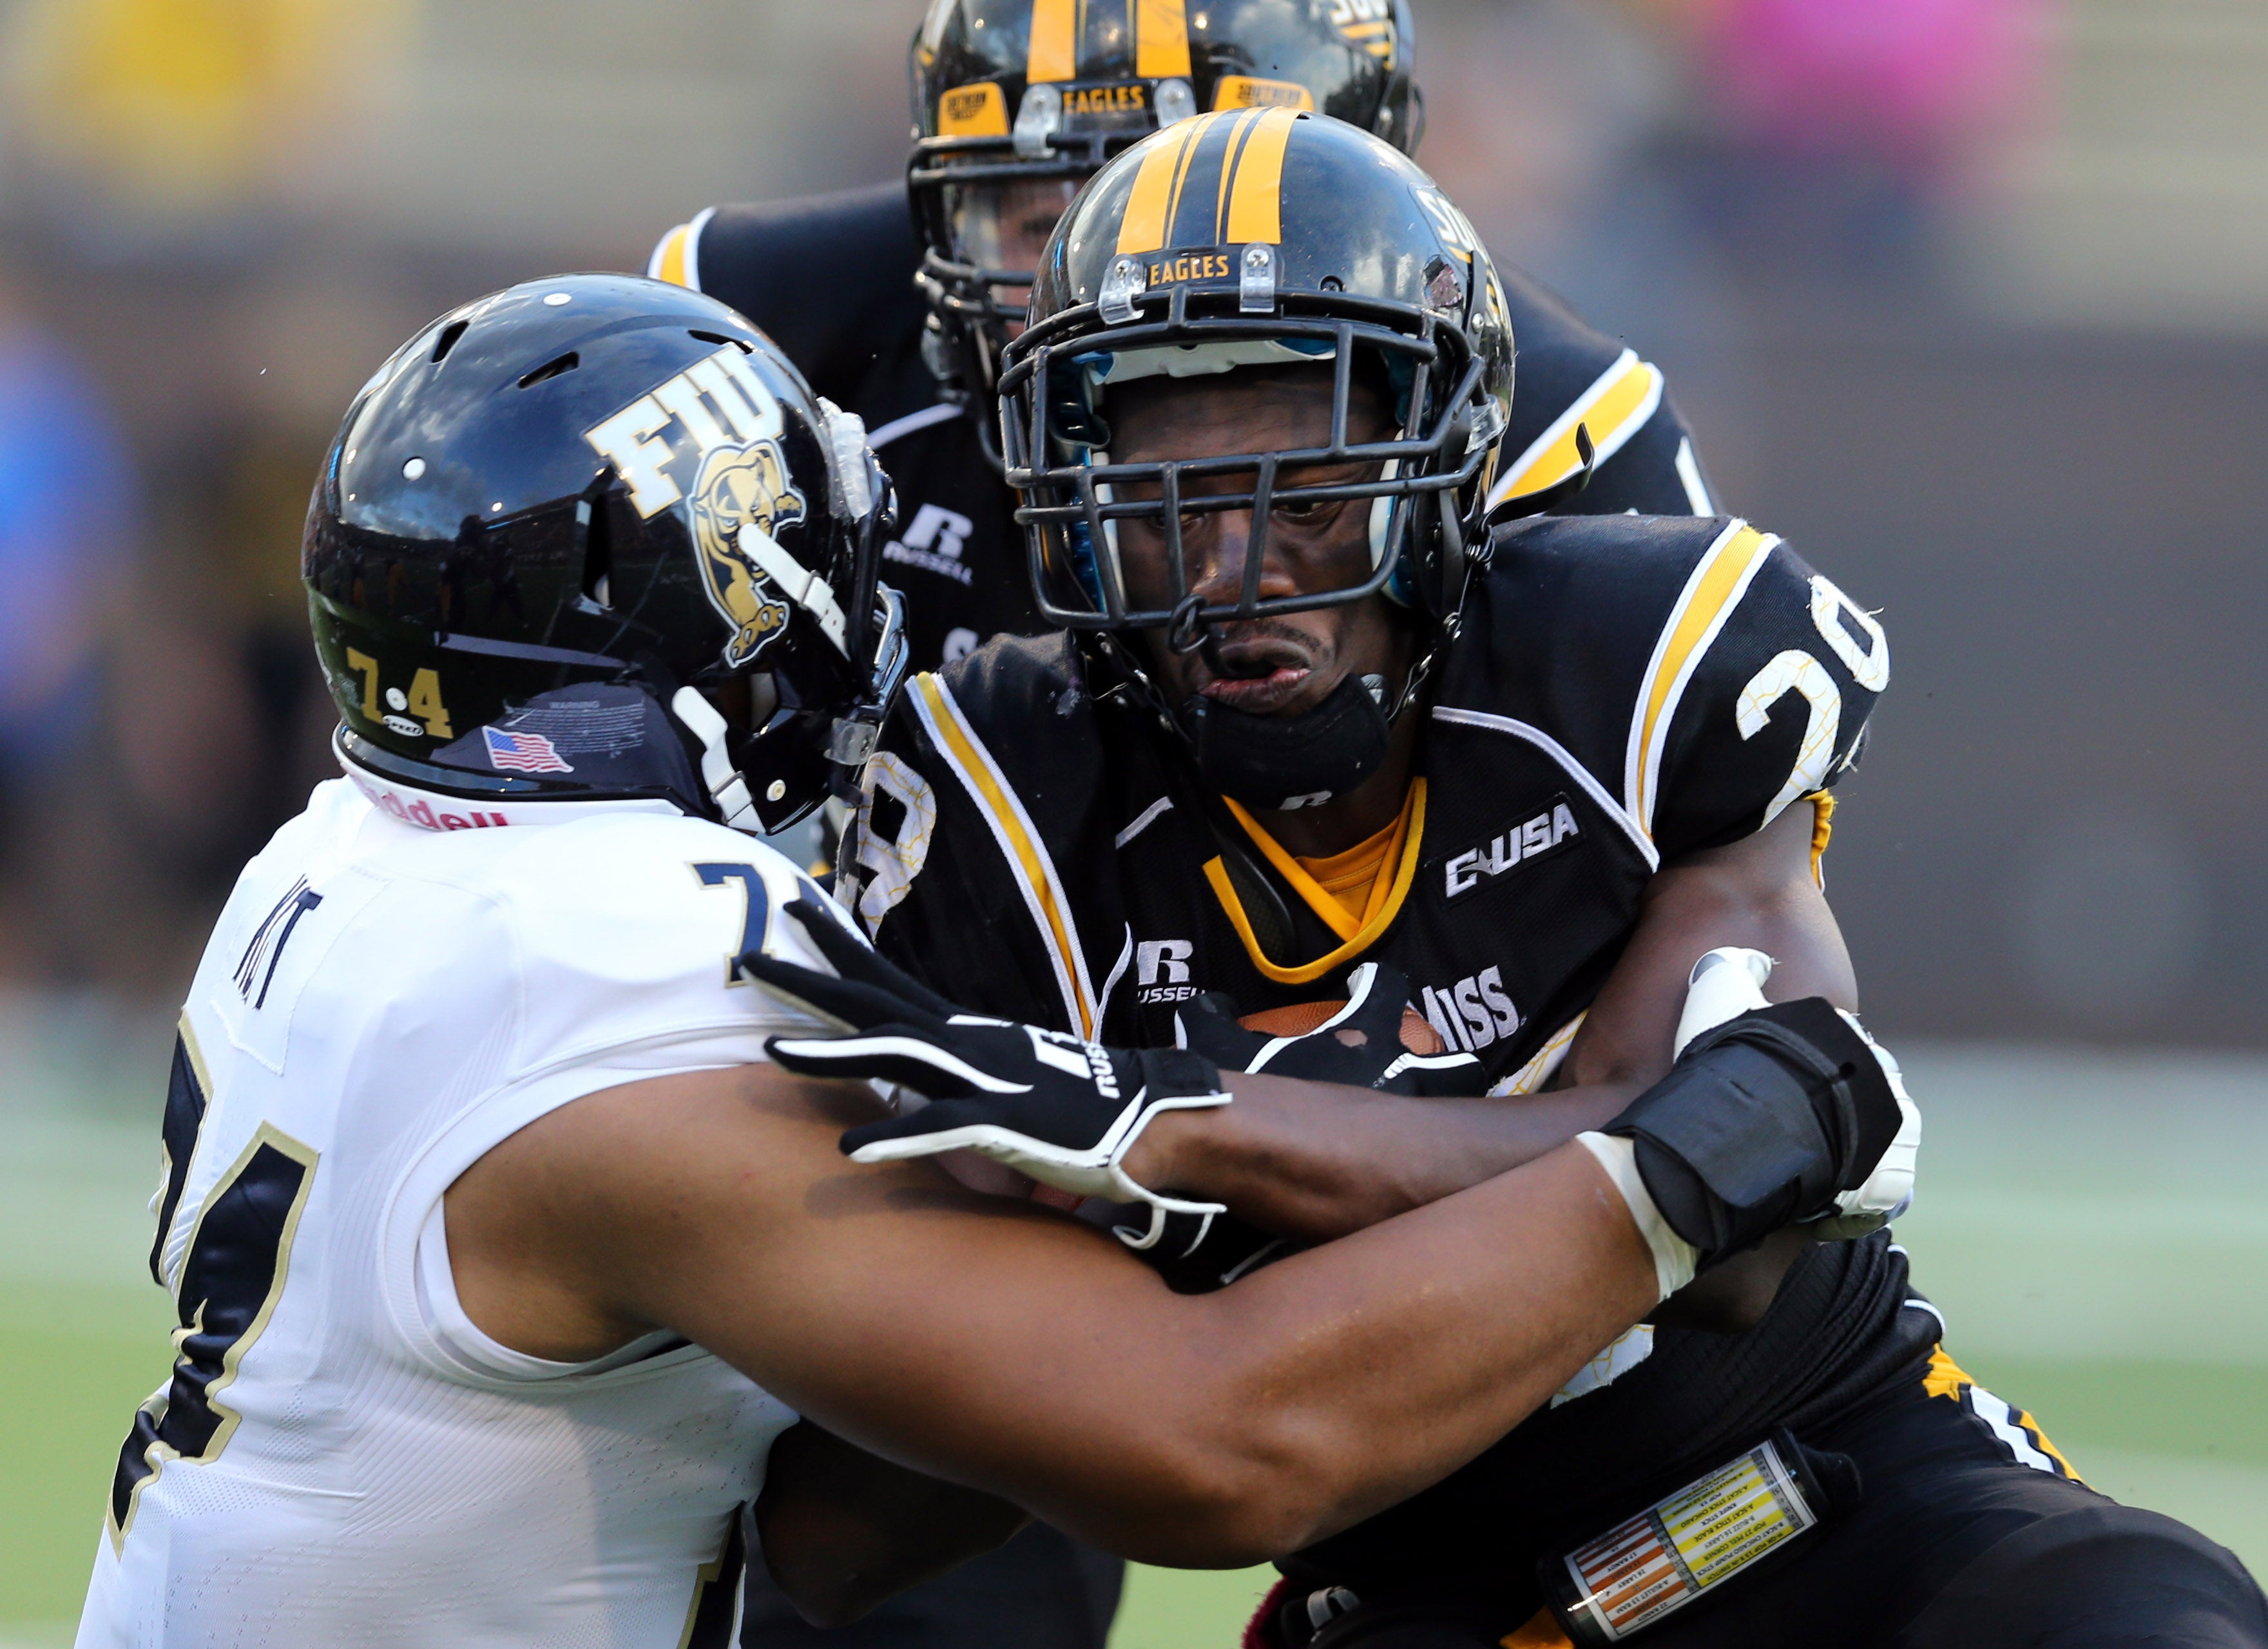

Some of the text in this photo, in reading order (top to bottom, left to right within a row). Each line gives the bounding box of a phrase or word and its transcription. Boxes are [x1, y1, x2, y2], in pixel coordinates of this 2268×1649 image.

[1062, 85, 1145, 115] EAGLES
[1149, 255, 1230, 287] EAGLES
[582, 344, 785, 520] FIU
[346, 645, 454, 739] 74
[1137, 939, 1193, 986] R
[1700, 1512, 1719, 1527] STICK
[1713, 1516, 1733, 1530] STICK
[1703, 1533, 1725, 1549] LARRY
